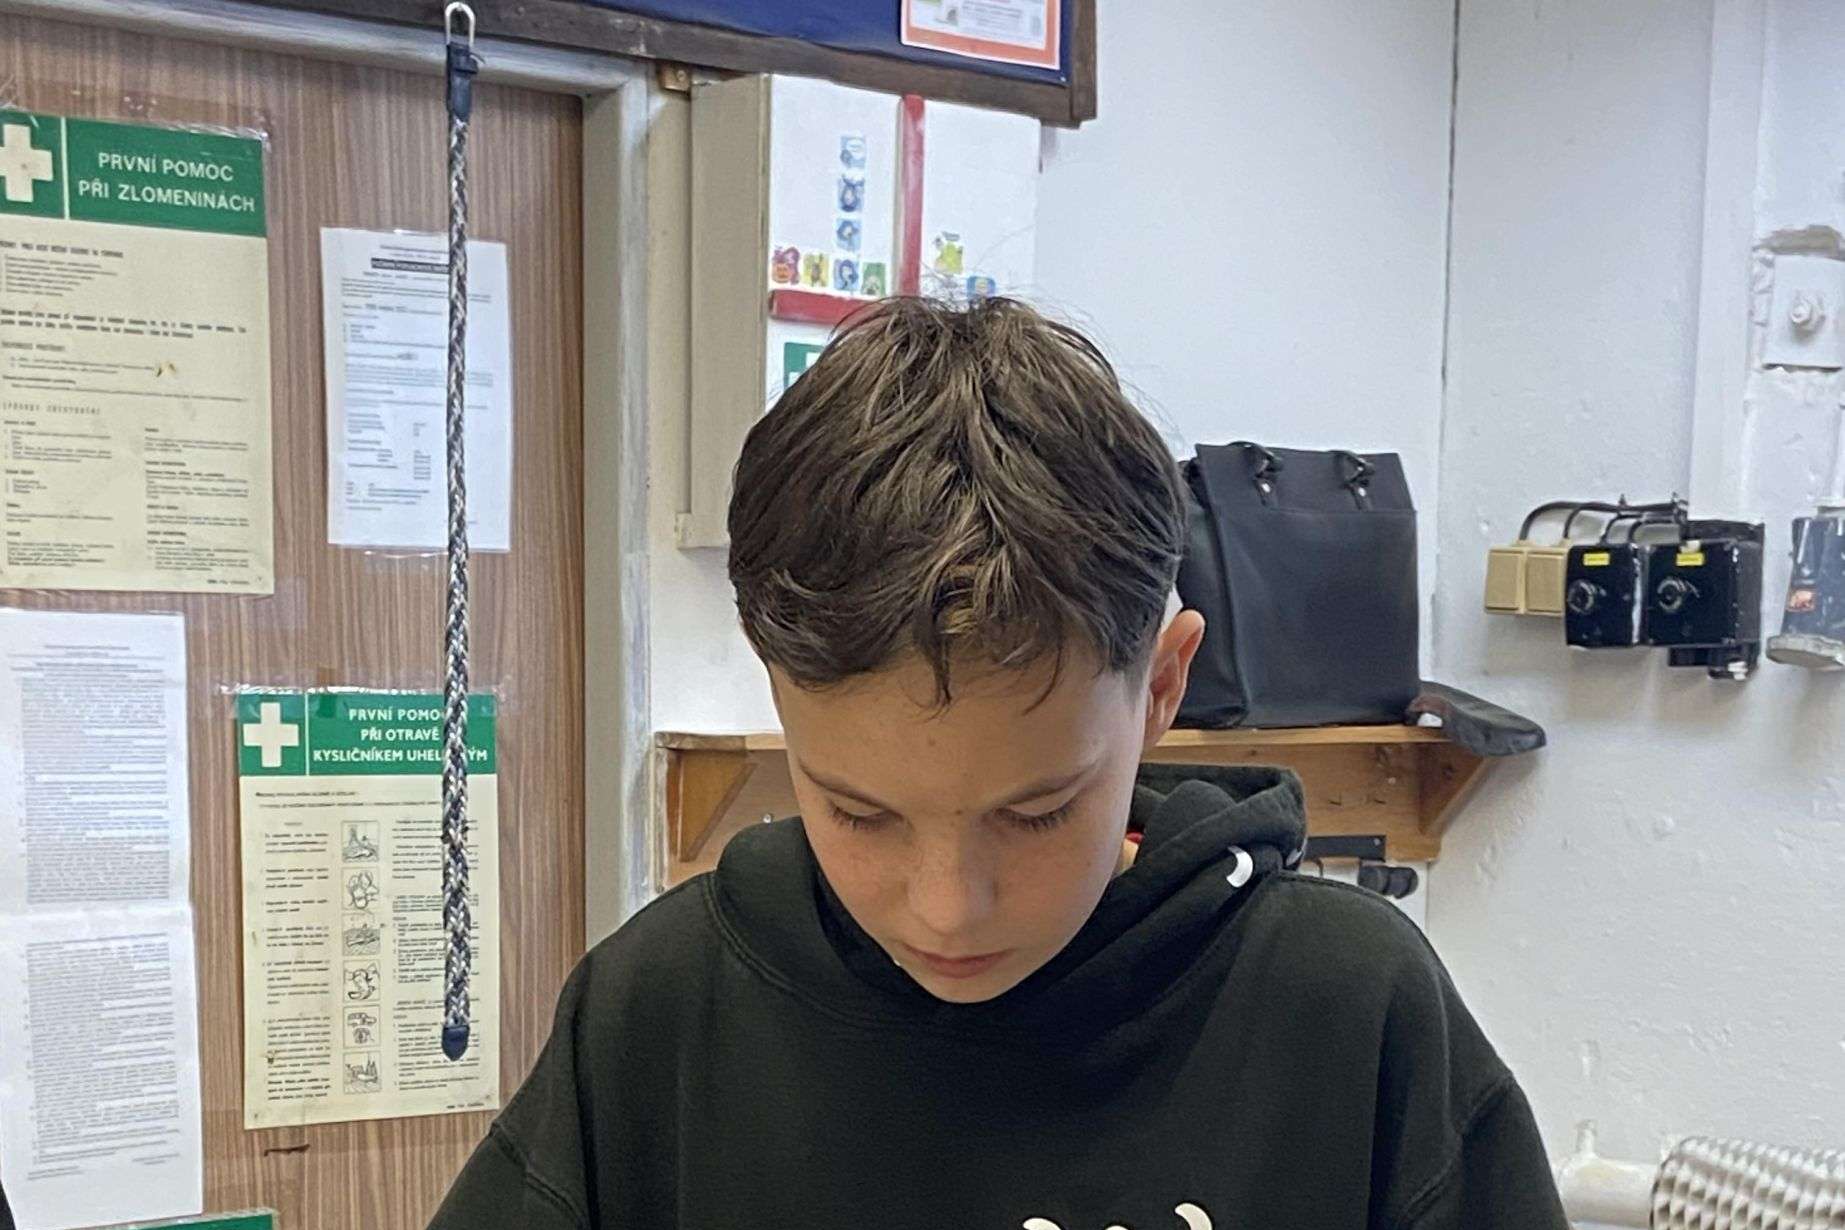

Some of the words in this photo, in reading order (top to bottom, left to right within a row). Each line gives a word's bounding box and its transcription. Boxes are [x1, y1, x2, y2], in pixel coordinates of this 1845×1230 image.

[98, 152, 157, 174] PRVNÍ
[162, 158, 234, 182] POMOC
[78, 177, 109, 199] PŘI
[118, 183, 255, 212] ZLOMENINÁCH
[348, 706, 392, 721] PRVNÍ
[398, 708, 444, 721] POMO
[360, 727, 382, 741] PŘI
[313, 745, 403, 762] KYSLIČNÍKEM
[407, 746, 488, 762] UHELÝM
